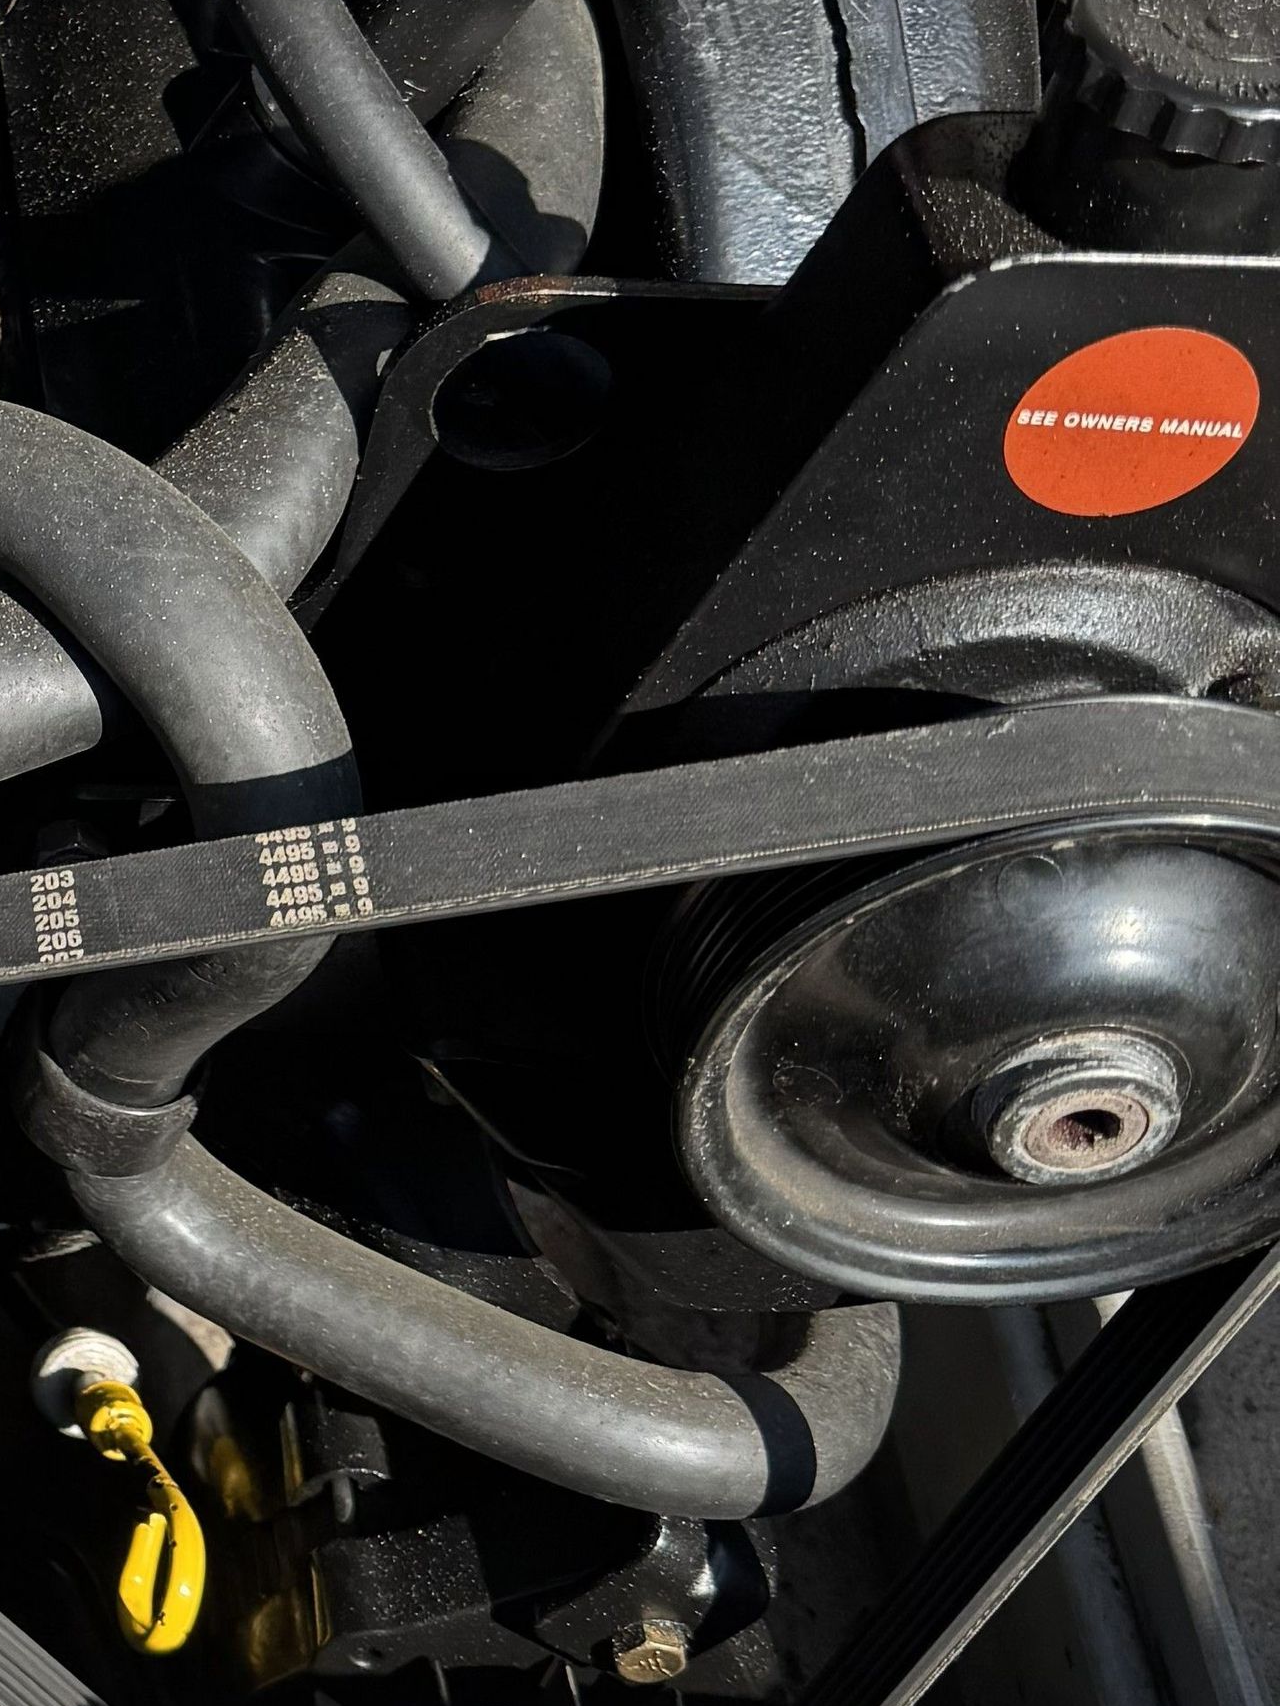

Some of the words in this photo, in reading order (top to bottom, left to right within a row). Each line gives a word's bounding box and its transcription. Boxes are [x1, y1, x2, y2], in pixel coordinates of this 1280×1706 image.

[1017, 409, 1058, 427] SEE
[1063, 412, 1154, 433] OWNERS
[1159, 418, 1243, 439] MANUAL
[30, 869, 75, 893] 203
[32, 889, 77, 912] 204
[34, 908, 80, 932] 205
[37, 929, 83, 953] 206
